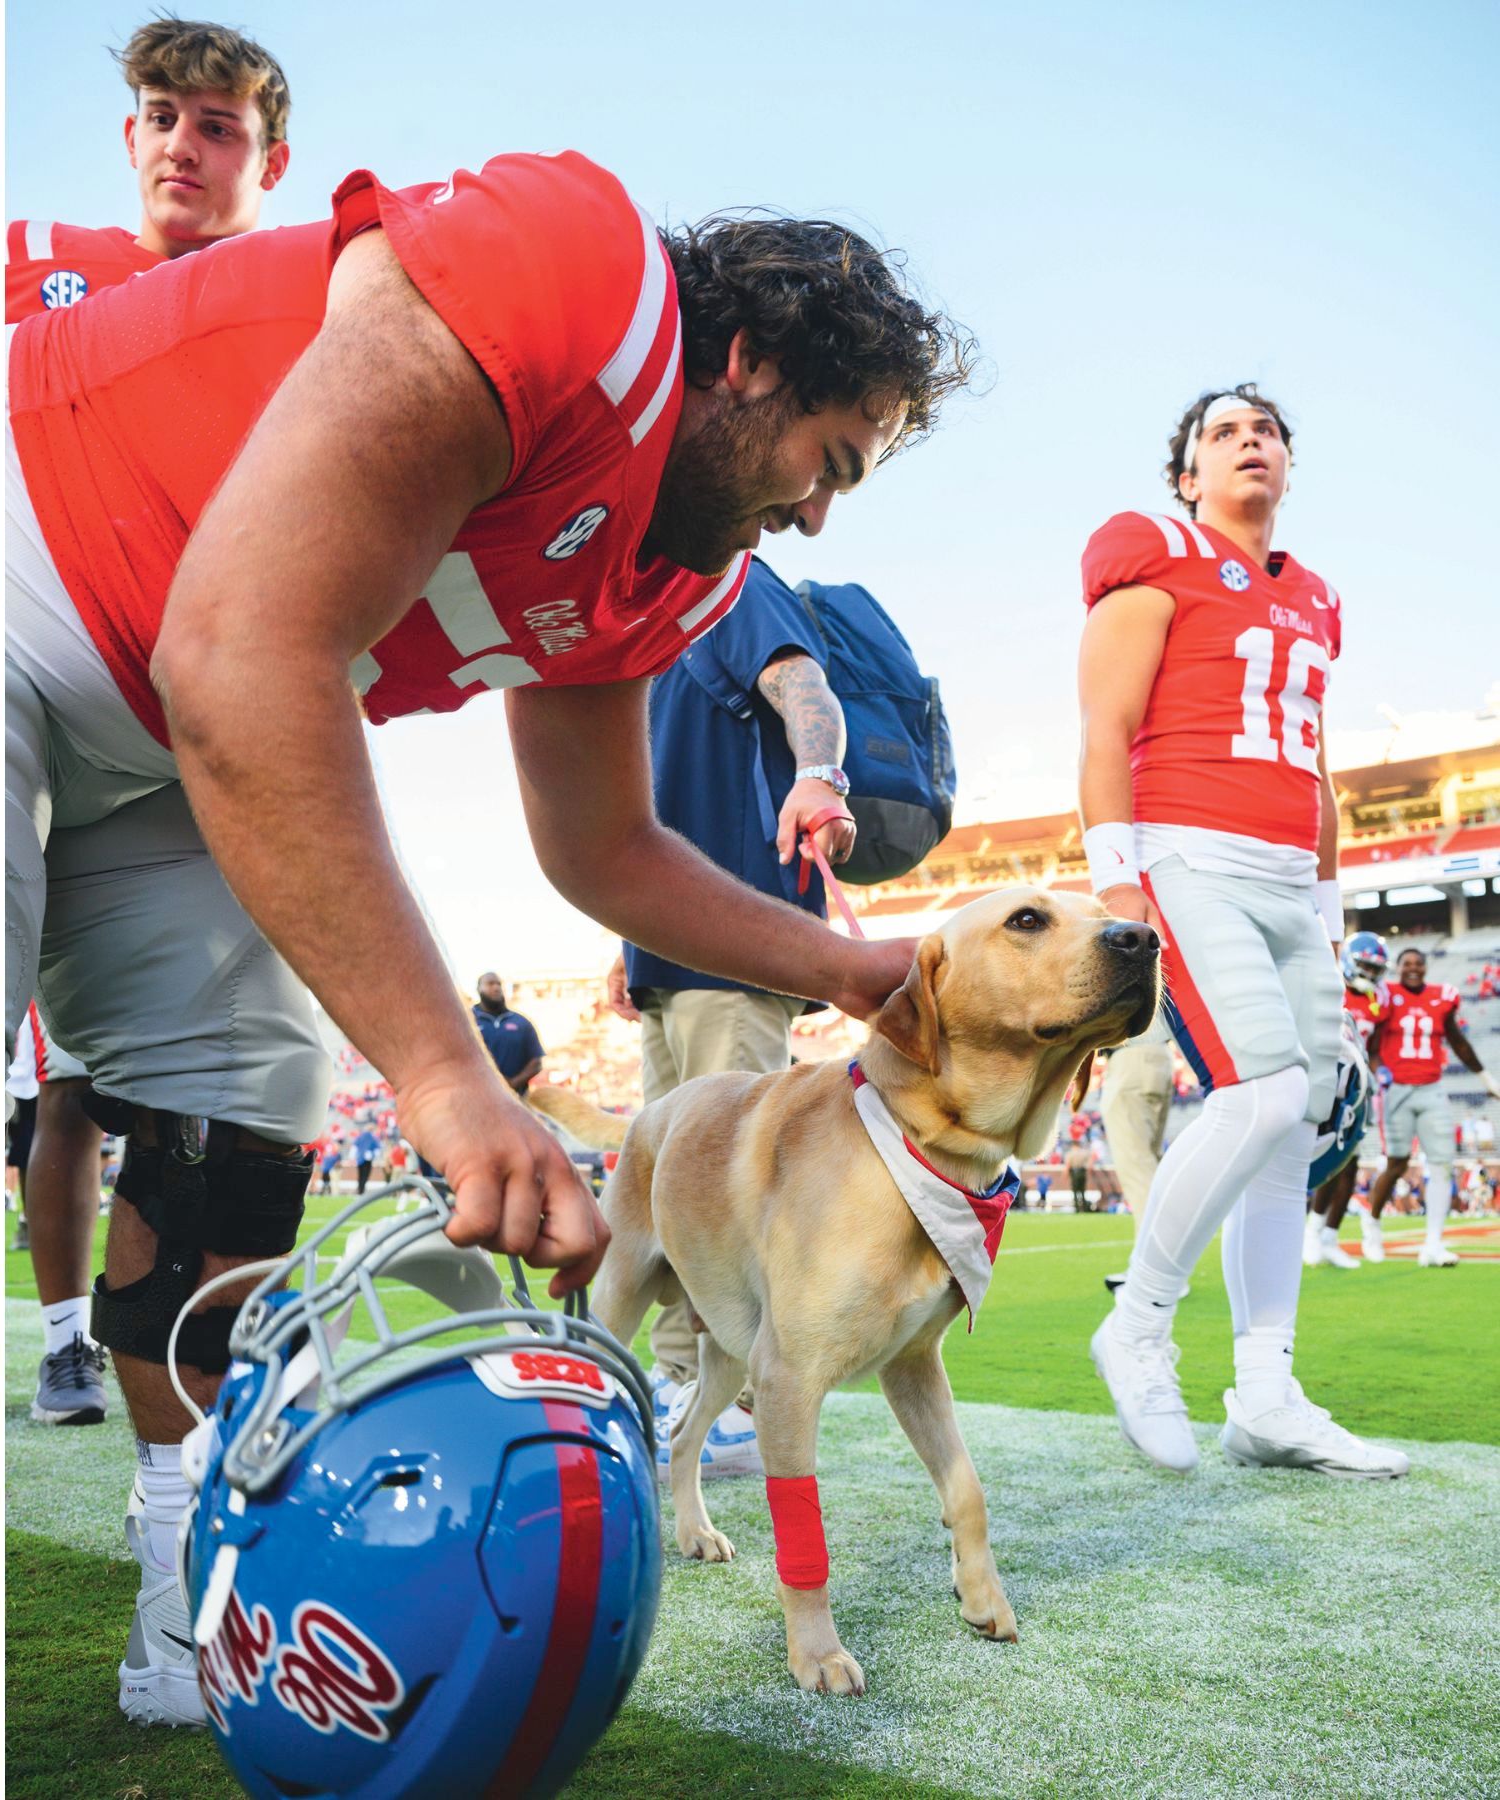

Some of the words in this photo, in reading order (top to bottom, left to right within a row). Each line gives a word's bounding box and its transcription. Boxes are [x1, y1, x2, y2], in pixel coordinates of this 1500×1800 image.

[42, 271, 86, 308] SEC
[522, 599, 580, 630] Ole
[1269, 603, 1286, 628] Ole
[1286, 608, 1313, 636] Miss
[535, 621, 589, 656] Miss
[1399, 1014, 1433, 1060] 11
[271, 1599, 404, 1743] Ole
